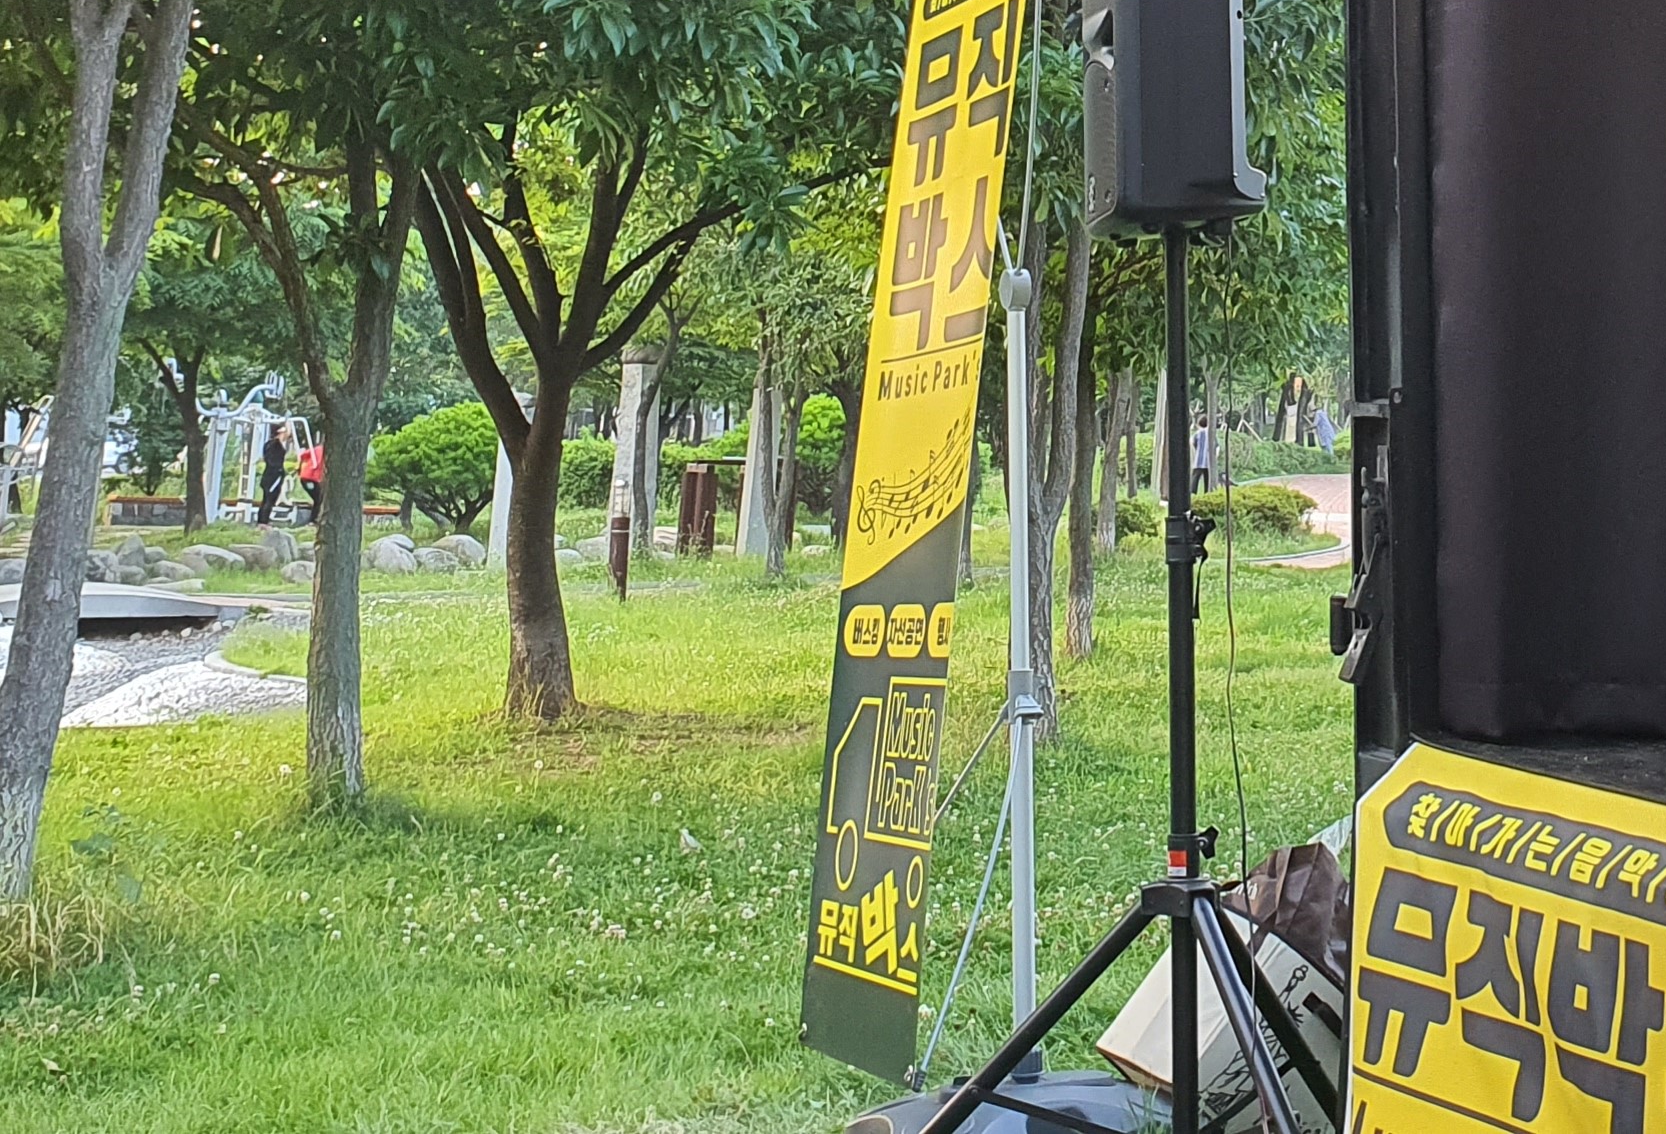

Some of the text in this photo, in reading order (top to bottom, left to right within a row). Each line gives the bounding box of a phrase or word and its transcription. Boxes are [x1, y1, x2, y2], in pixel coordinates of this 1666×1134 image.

[890, 176, 992, 351] 박스
[878, 364, 927, 401] Music
[852, 618, 880, 644] 버스킹
[887, 618, 924, 645] 자선공연
[886, 691, 936, 762] Music
[817, 869, 919, 983] 뮤직박스
